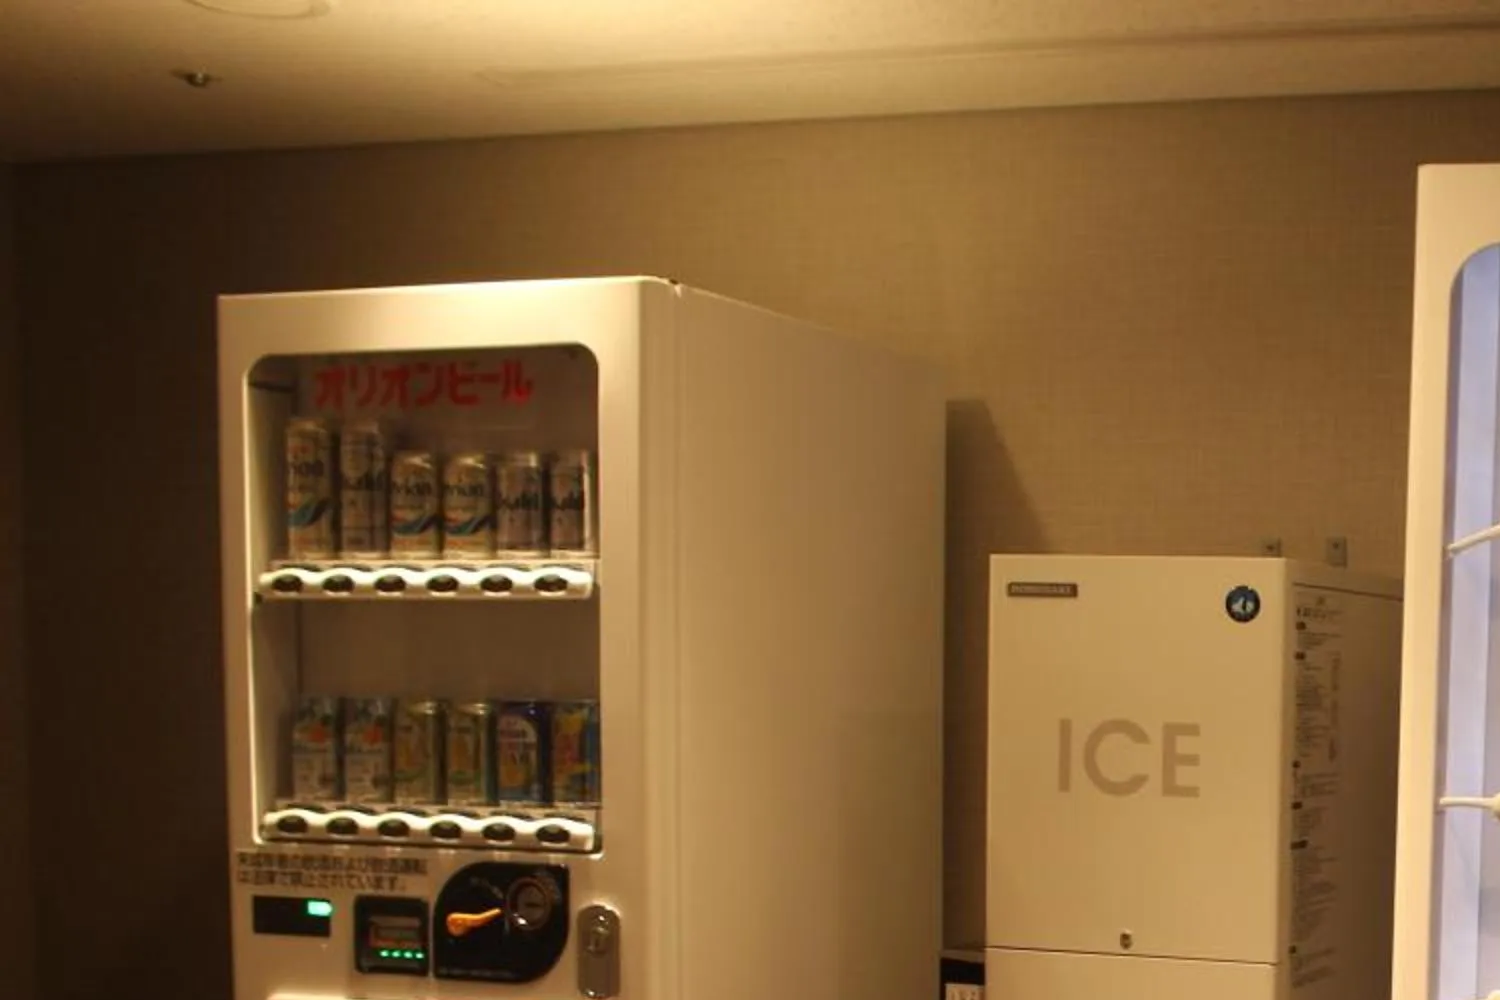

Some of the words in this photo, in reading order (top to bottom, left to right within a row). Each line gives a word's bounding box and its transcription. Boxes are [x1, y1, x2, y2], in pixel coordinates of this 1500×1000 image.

[314, 358, 533, 407] オリオンビール
[1058, 718, 1201, 798] ICE
